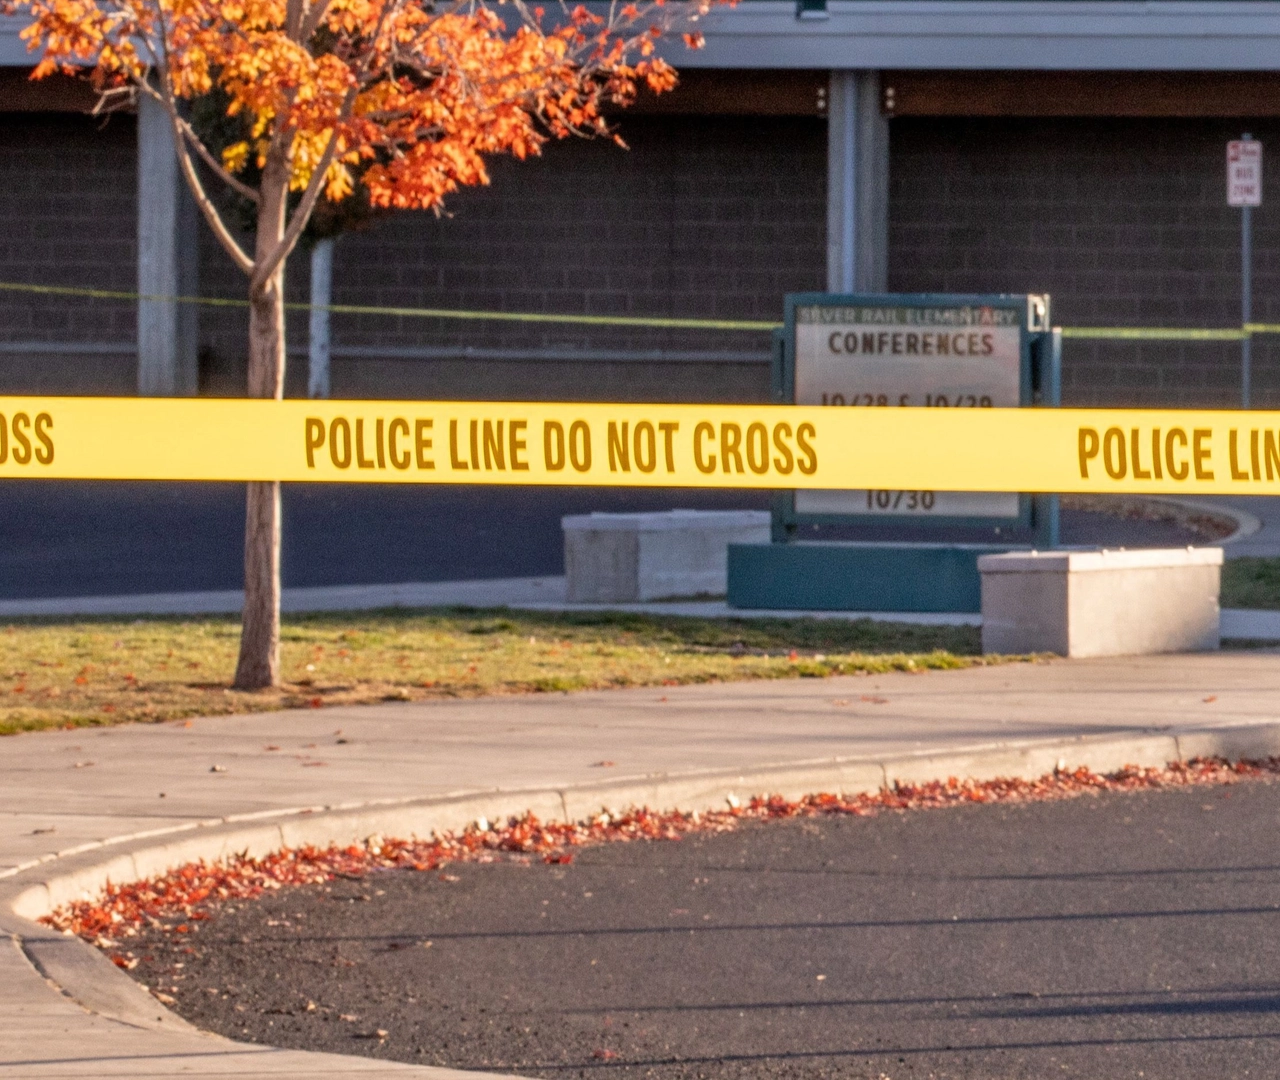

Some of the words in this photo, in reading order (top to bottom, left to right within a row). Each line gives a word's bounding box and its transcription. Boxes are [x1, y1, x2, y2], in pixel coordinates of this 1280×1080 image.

[828, 331, 994, 355] CONFERENCES
[305, 416, 436, 471] POLICE
[449, 418, 530, 472] LINE
[543, 419, 592, 473] DO
[607, 420, 680, 474] NOT
[693, 421, 818, 476] CROSS
[1078, 426, 1215, 481] POLICE
[866, 489, 936, 509] 10/30
